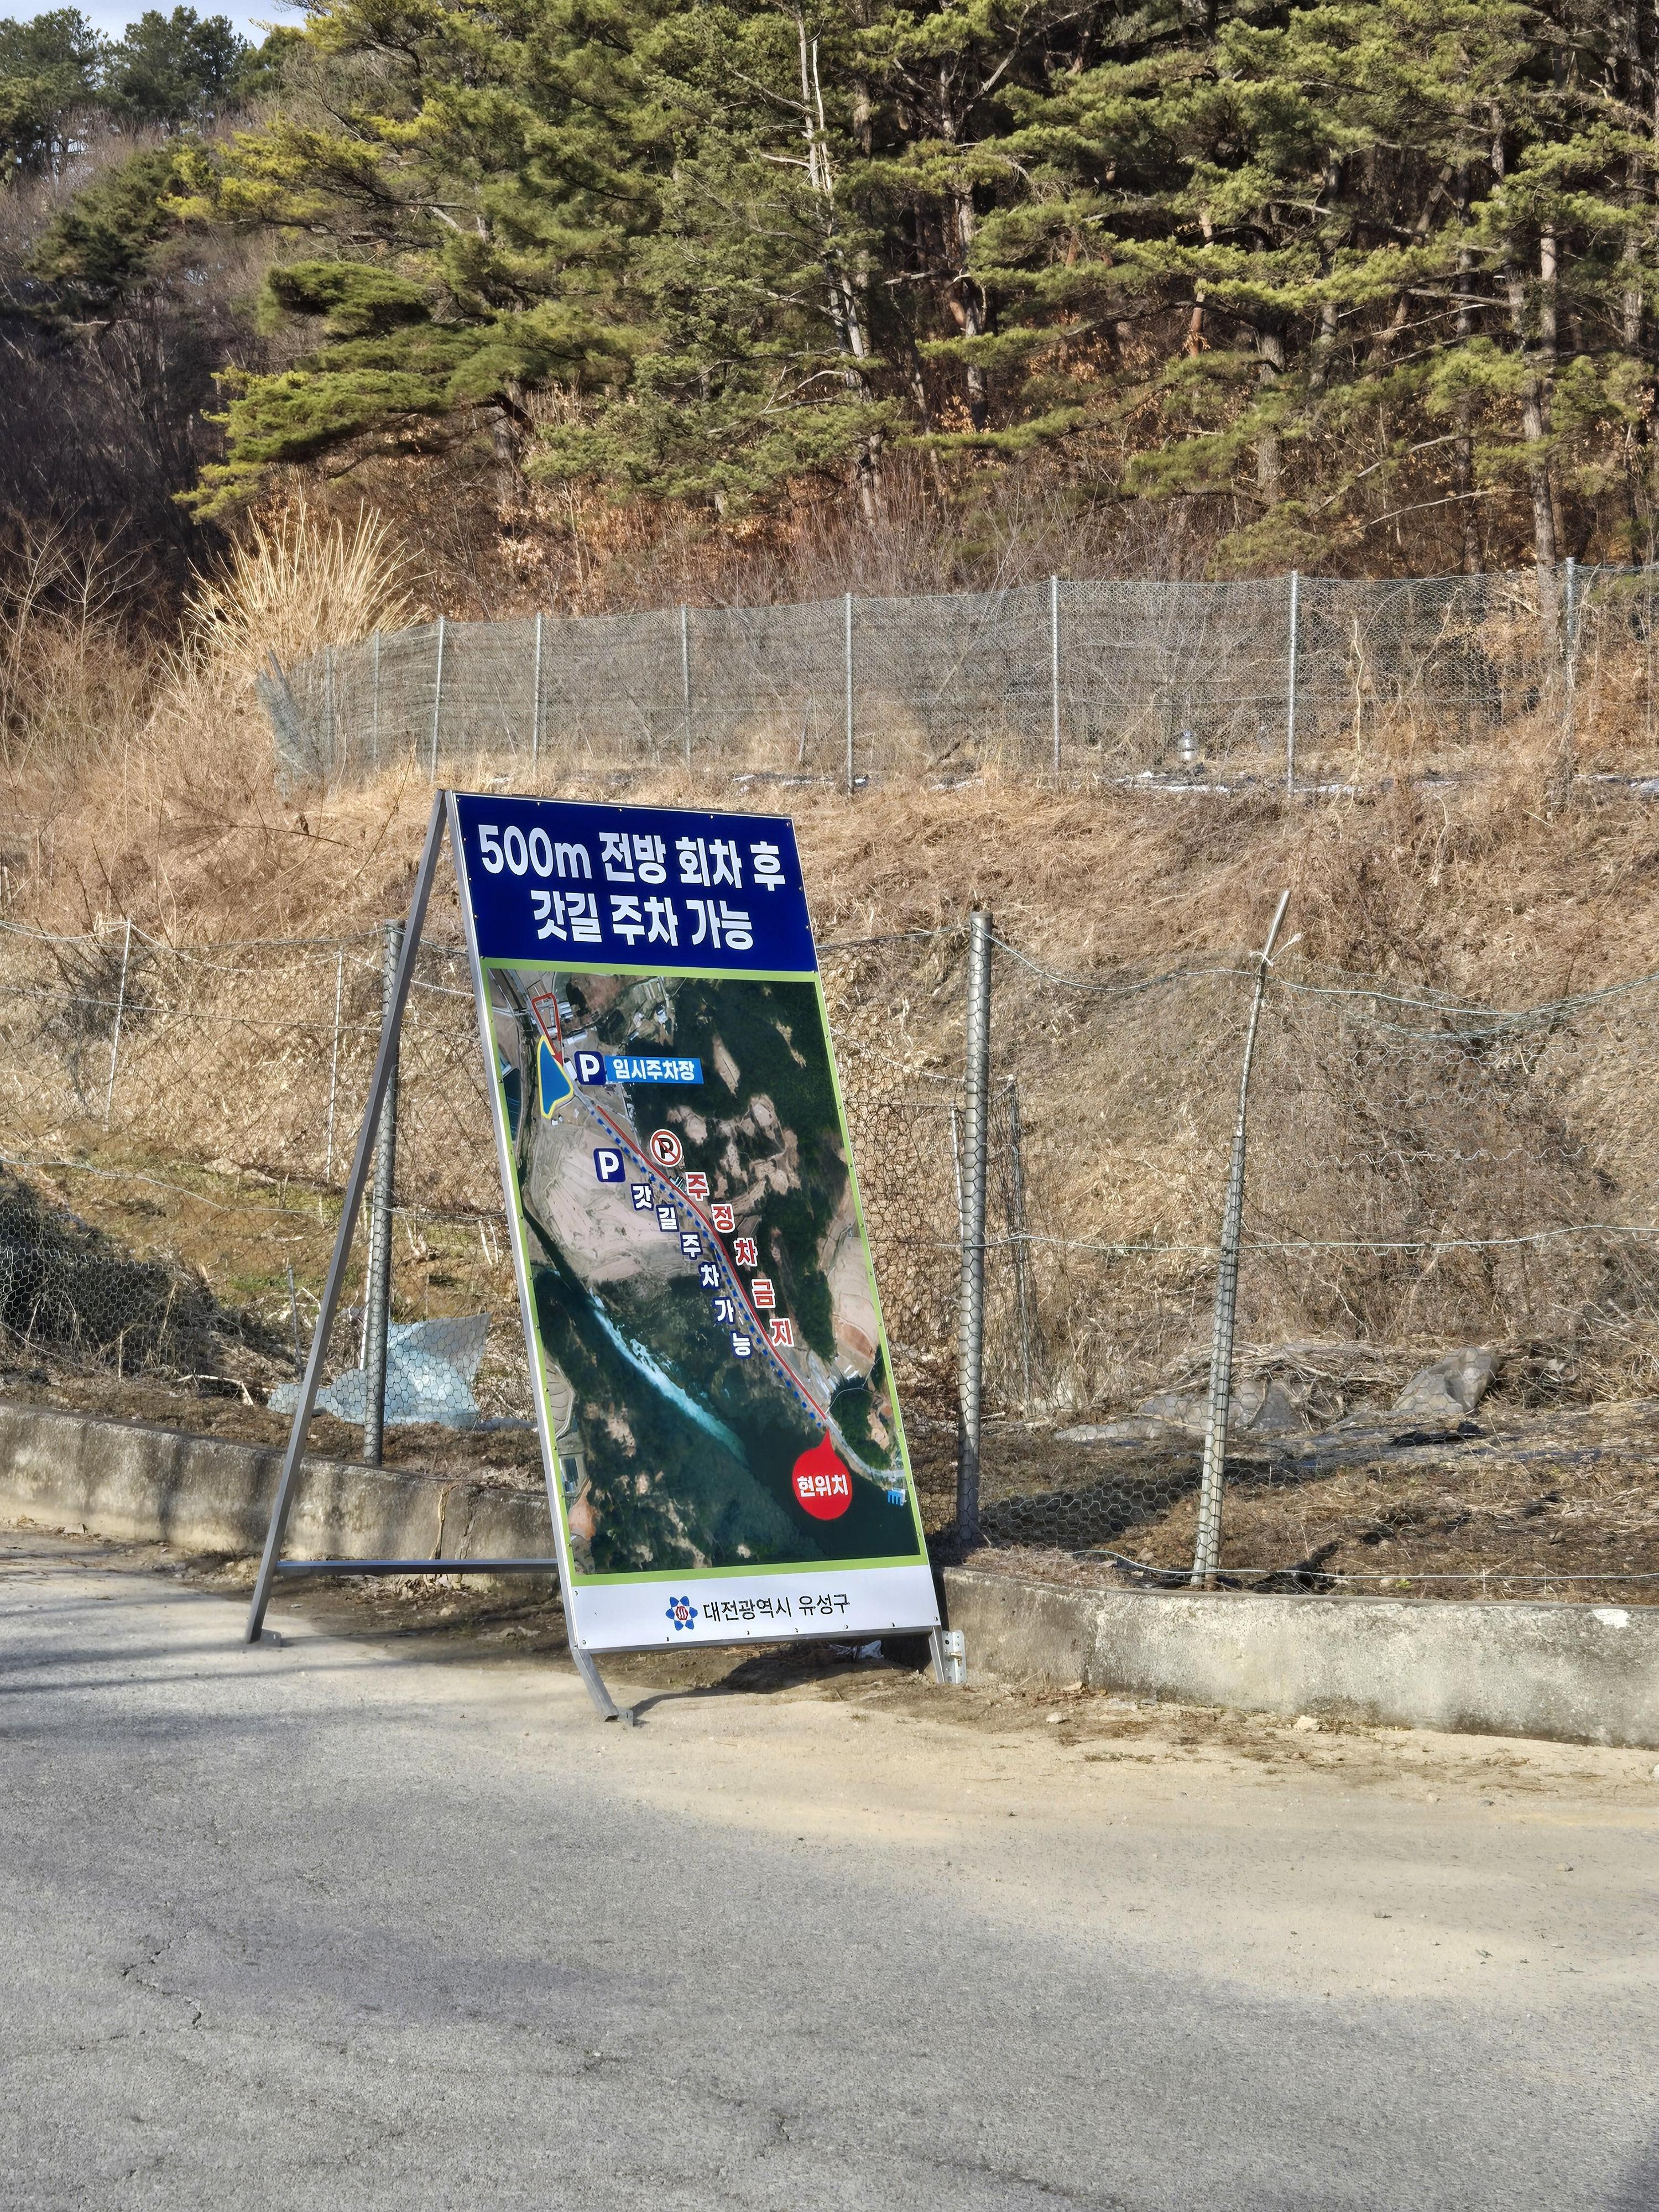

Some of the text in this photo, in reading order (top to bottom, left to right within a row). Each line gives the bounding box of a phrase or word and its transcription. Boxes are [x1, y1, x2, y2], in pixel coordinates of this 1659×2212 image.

[478, 824, 786, 891] 500m 전방 회차 후
[530, 890, 753, 951] 갓길 주차 가능
[580, 1053, 695, 1082] P 임시주차장
[598, 1151, 619, 1180] P
[797, 1474, 848, 1498] 현위치
[703, 1593, 850, 1622] 대전광역시 유성구
